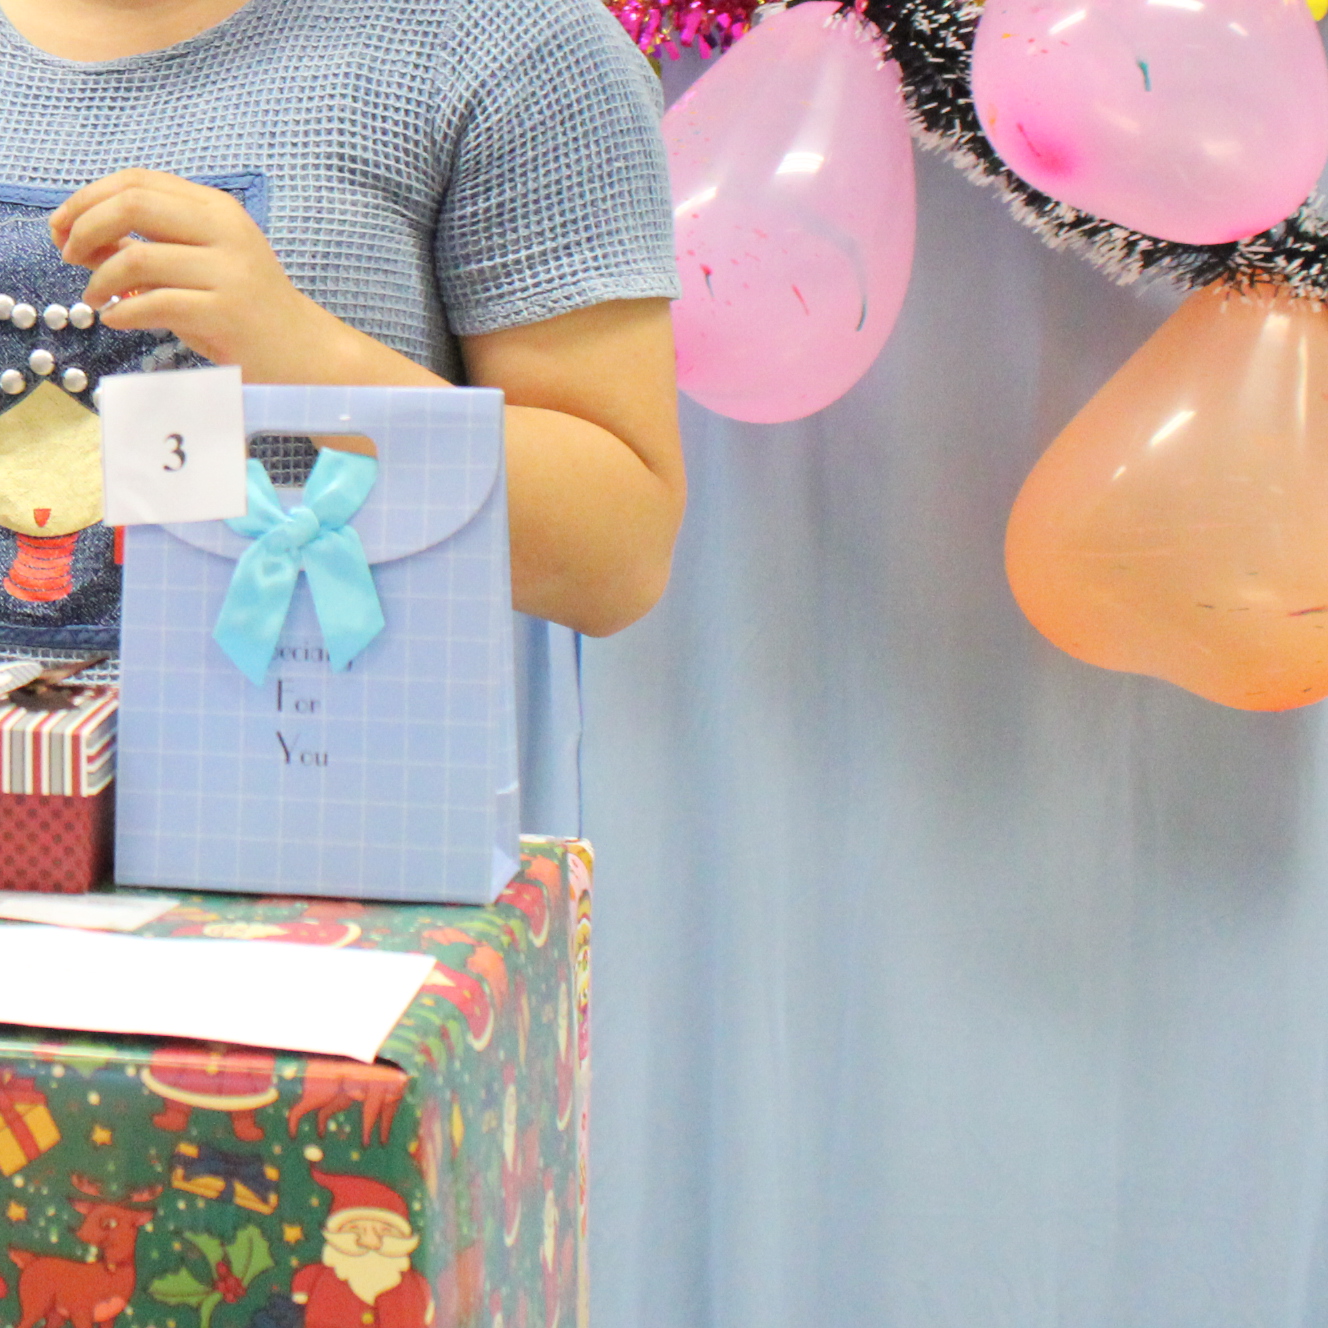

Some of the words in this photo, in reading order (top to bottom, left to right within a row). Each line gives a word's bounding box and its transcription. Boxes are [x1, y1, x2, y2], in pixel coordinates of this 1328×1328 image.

[162, 433, 186, 473] 3
[276, 678, 321, 714] For
[275, 730, 329, 767] You
